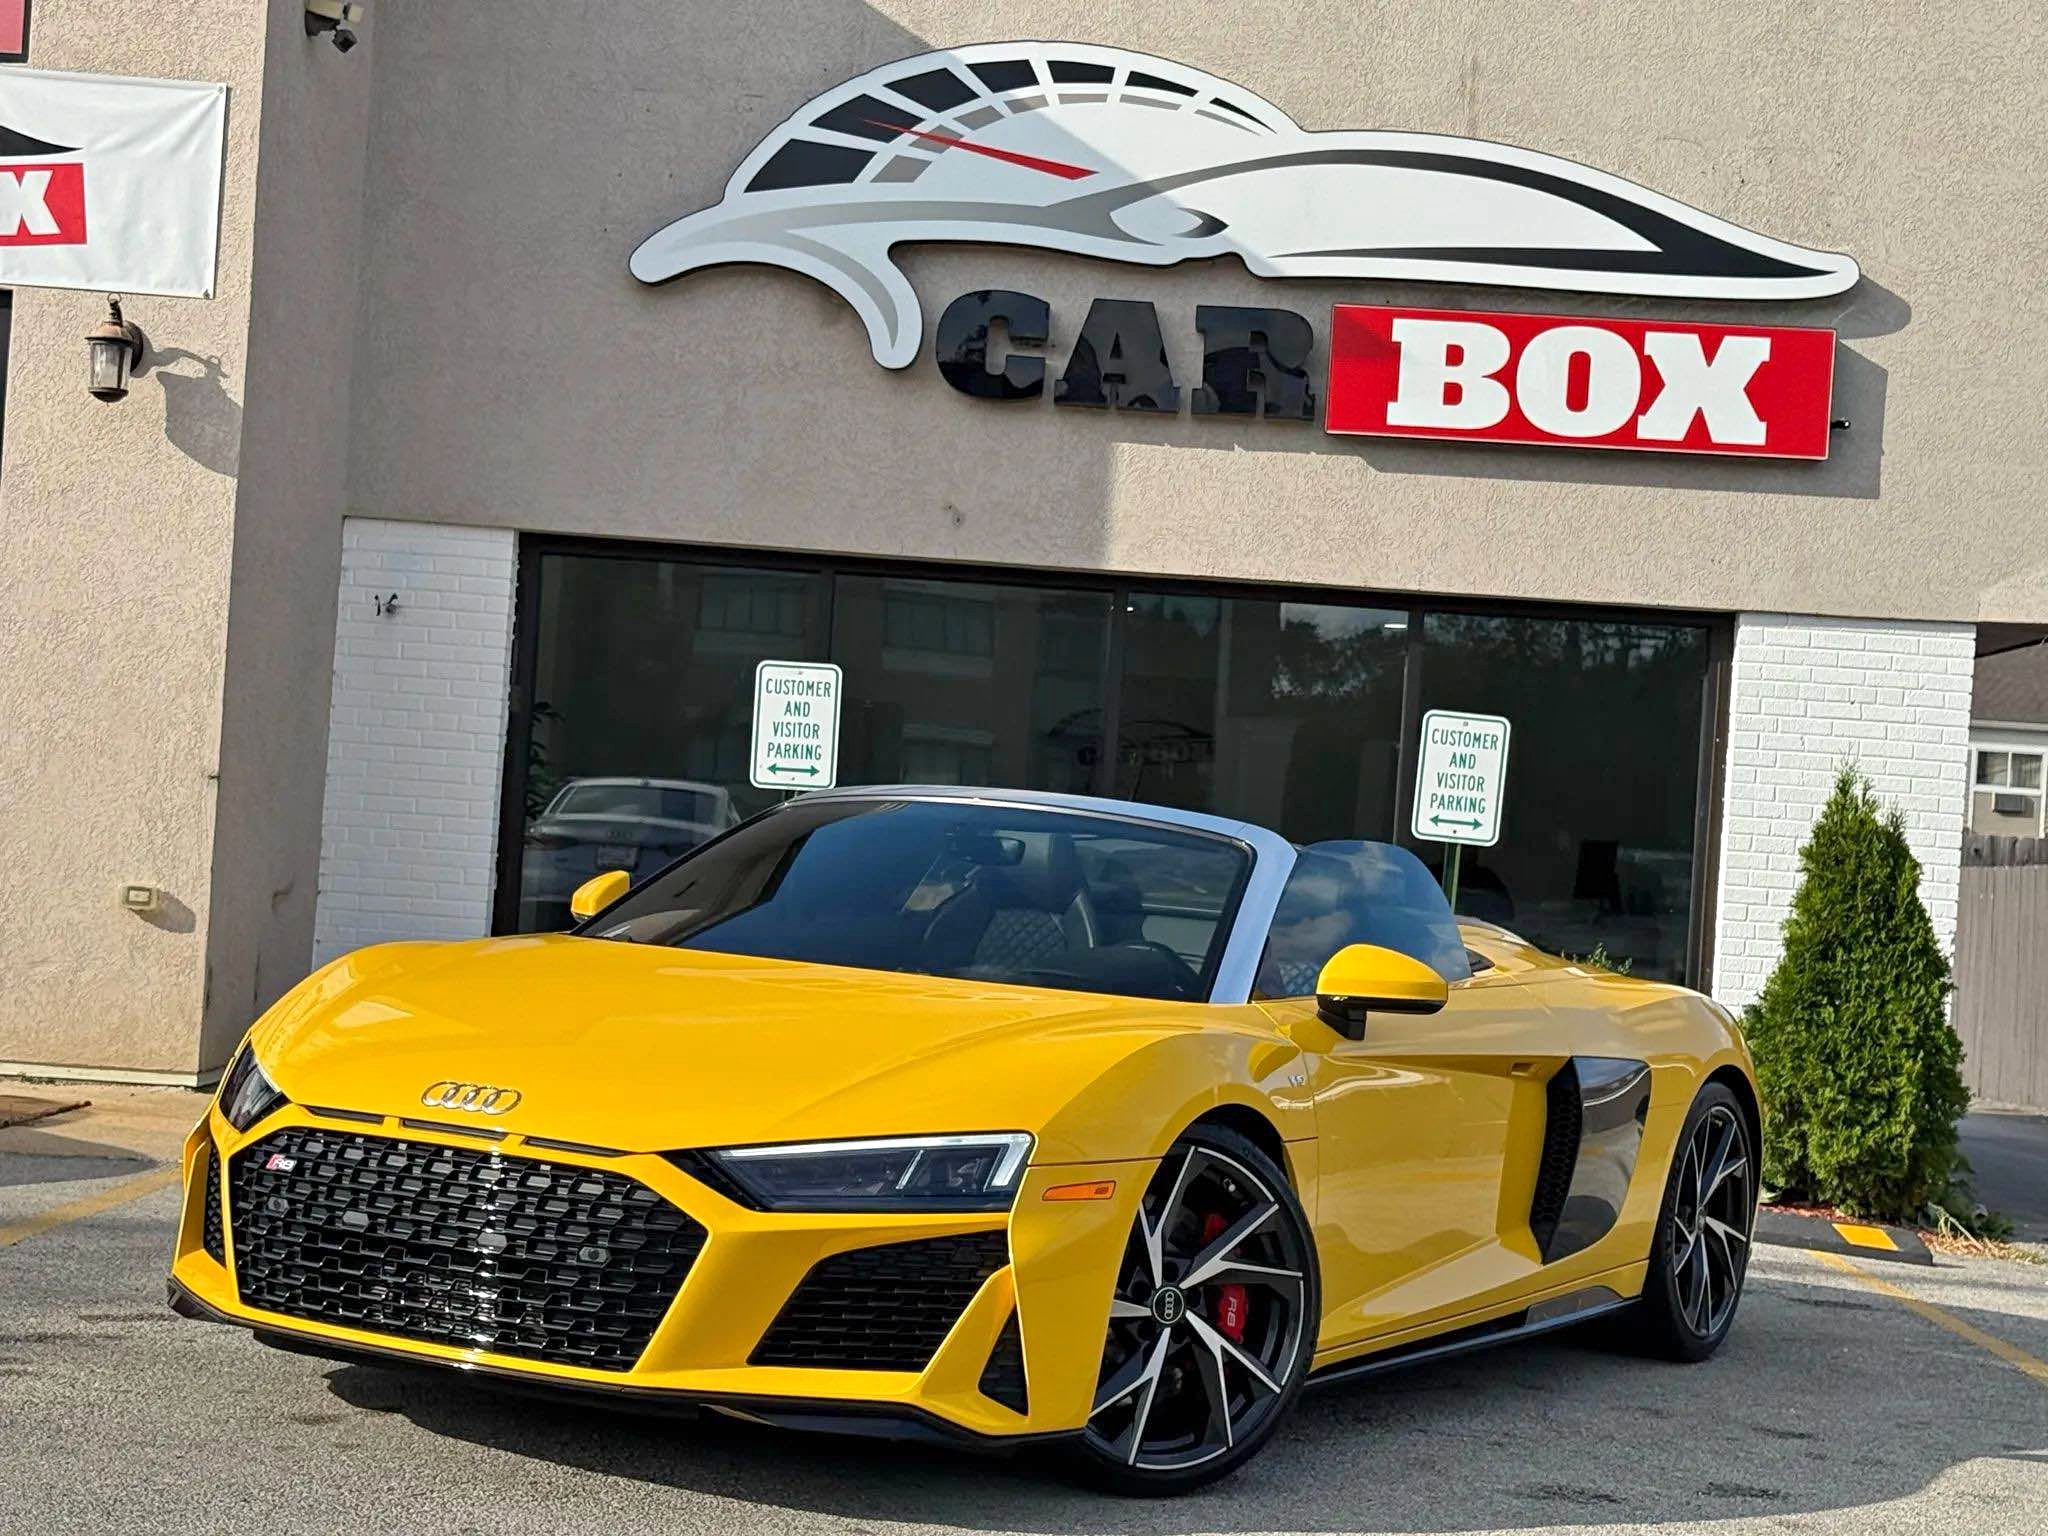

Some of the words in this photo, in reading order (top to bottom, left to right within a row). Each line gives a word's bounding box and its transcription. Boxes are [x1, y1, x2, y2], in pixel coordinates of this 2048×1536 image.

[936, 290, 1315, 420] CAR
[1386, 318, 1771, 446] BOX
[765, 678, 831, 698] CUSTOMER
[784, 700, 811, 718] AND
[772, 721, 820, 740] VISITOR
[1432, 728, 1499, 750] CUSTOMER
[766, 742, 822, 761] PARKING
[1449, 751, 1476, 769] AND
[1437, 771, 1485, 793] VISITOR
[1430, 793, 1486, 815] PARKING
